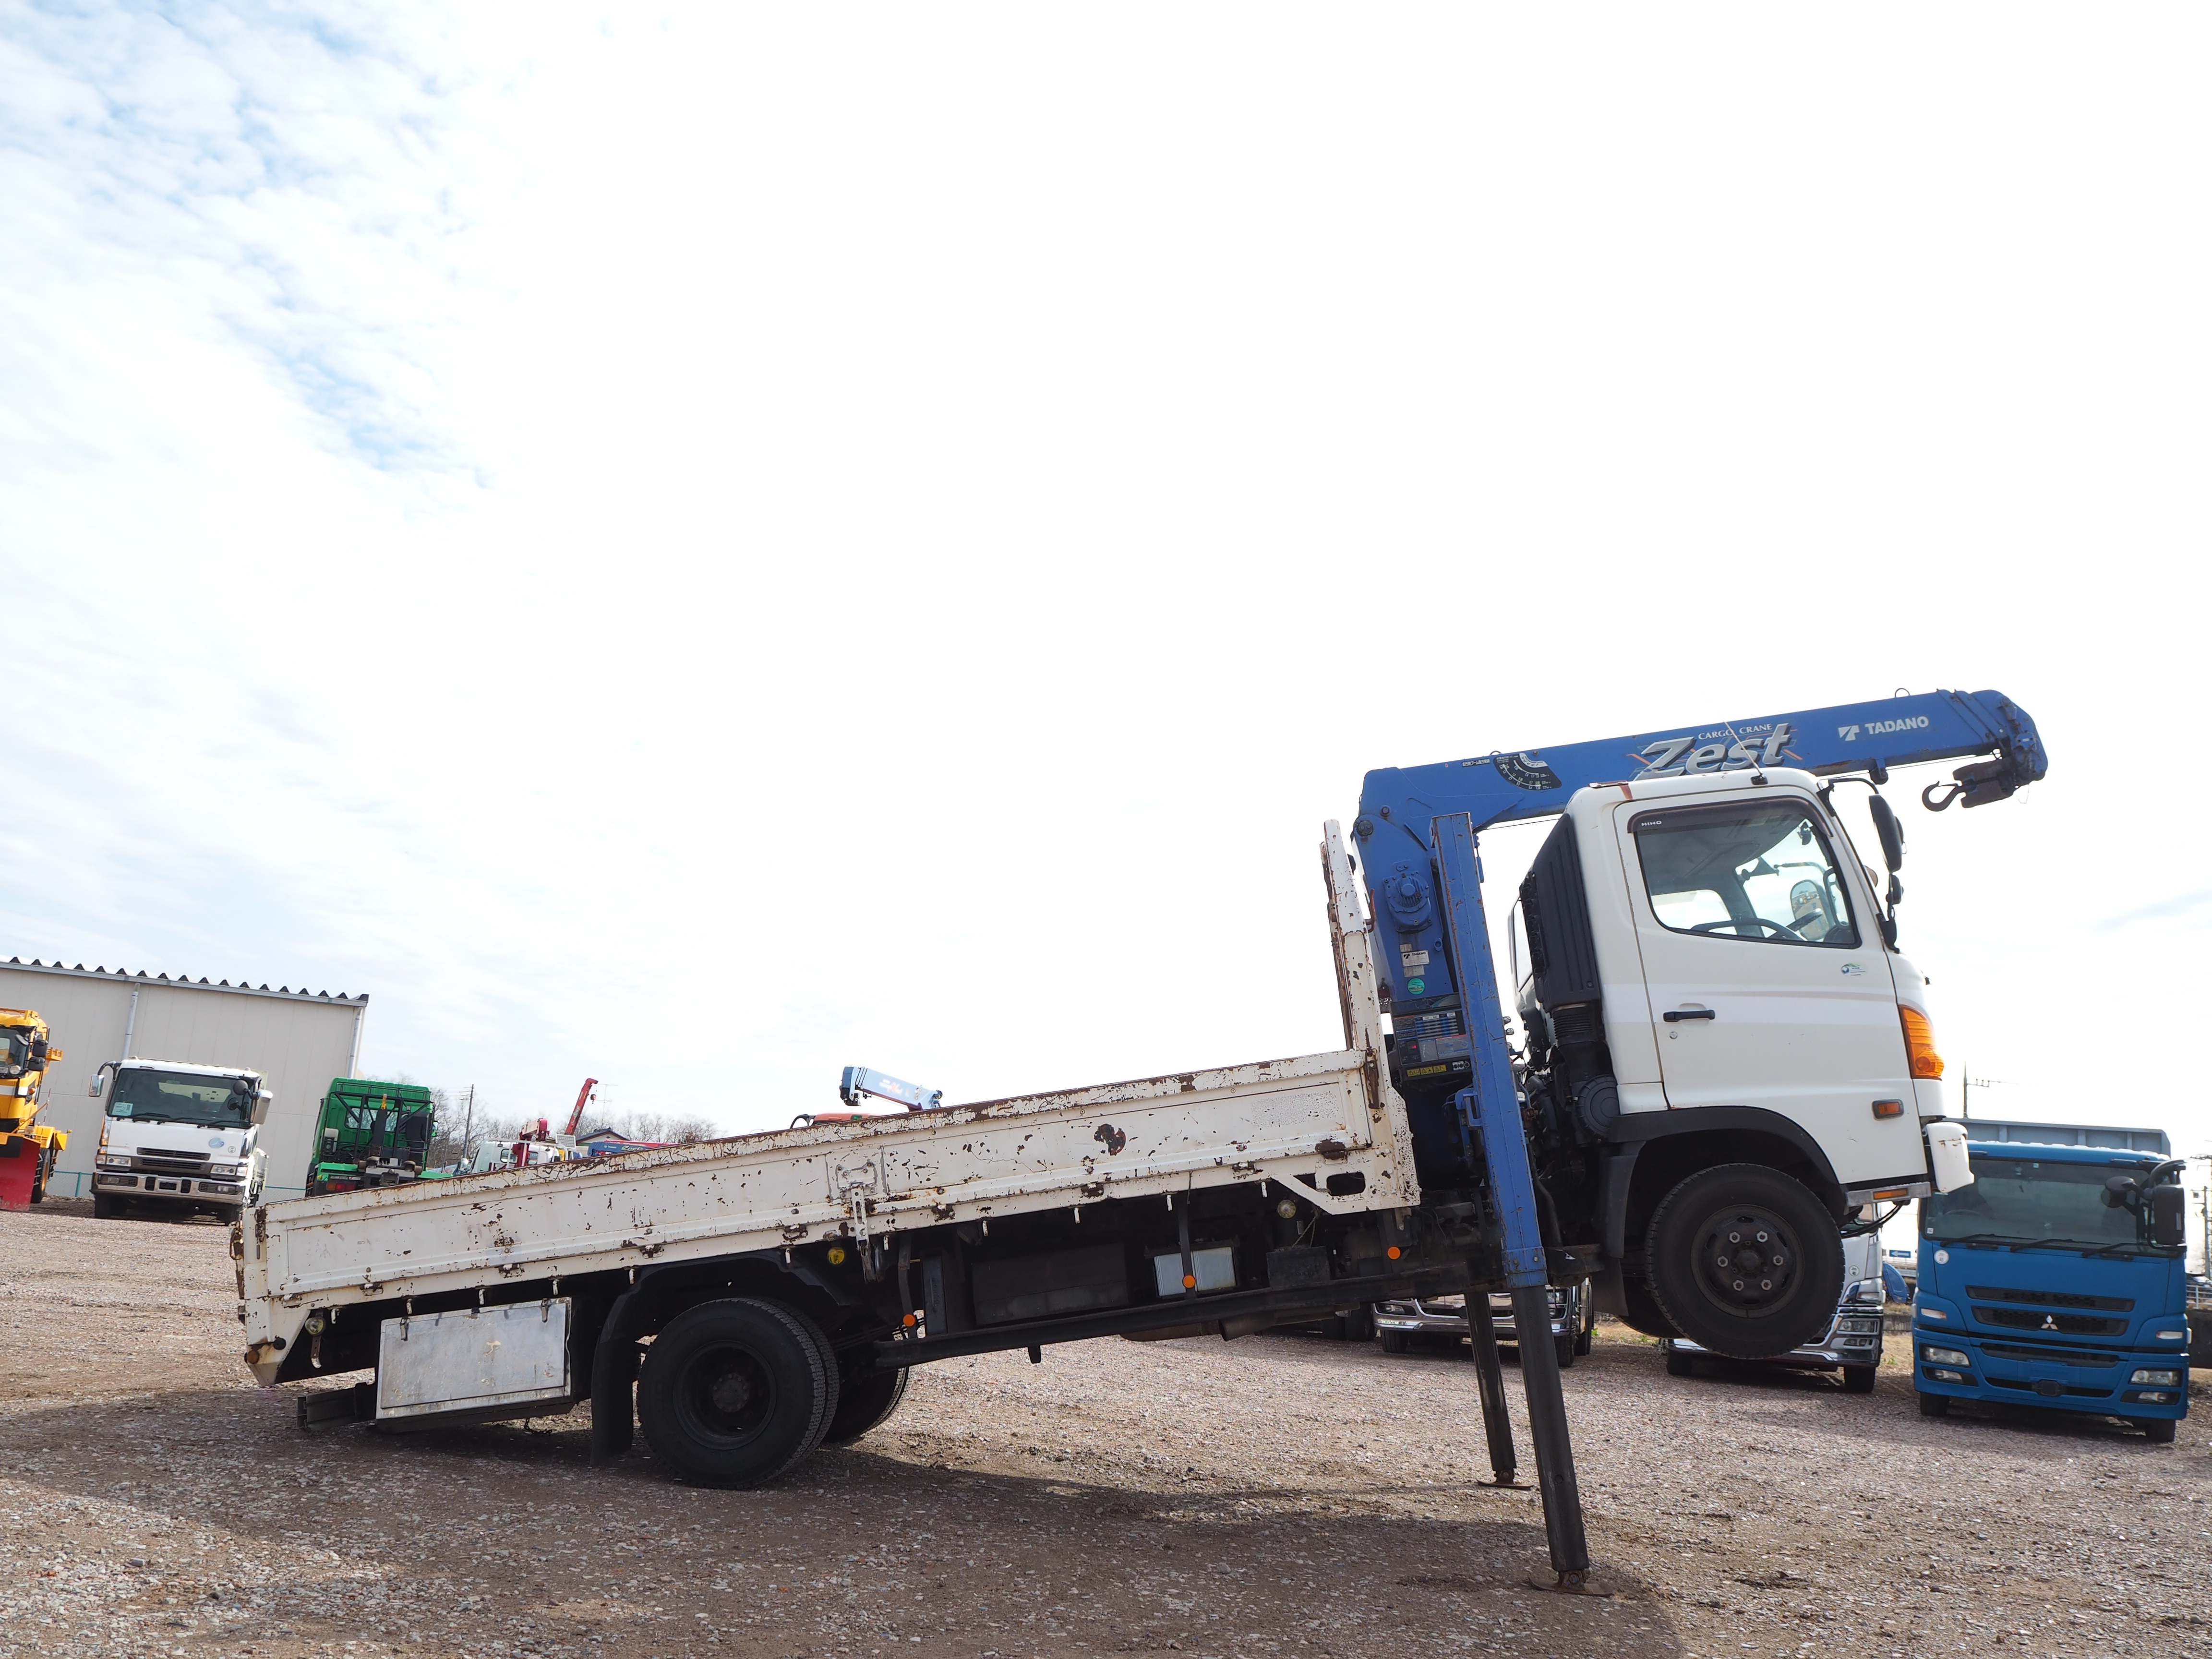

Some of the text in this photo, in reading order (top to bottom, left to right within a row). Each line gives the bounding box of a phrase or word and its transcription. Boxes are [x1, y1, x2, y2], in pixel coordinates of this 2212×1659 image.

[1698, 723, 1773, 740] CARGO CRANE
[1864, 716, 1929, 734] TADANO
[1633, 722, 1791, 781] Zest
